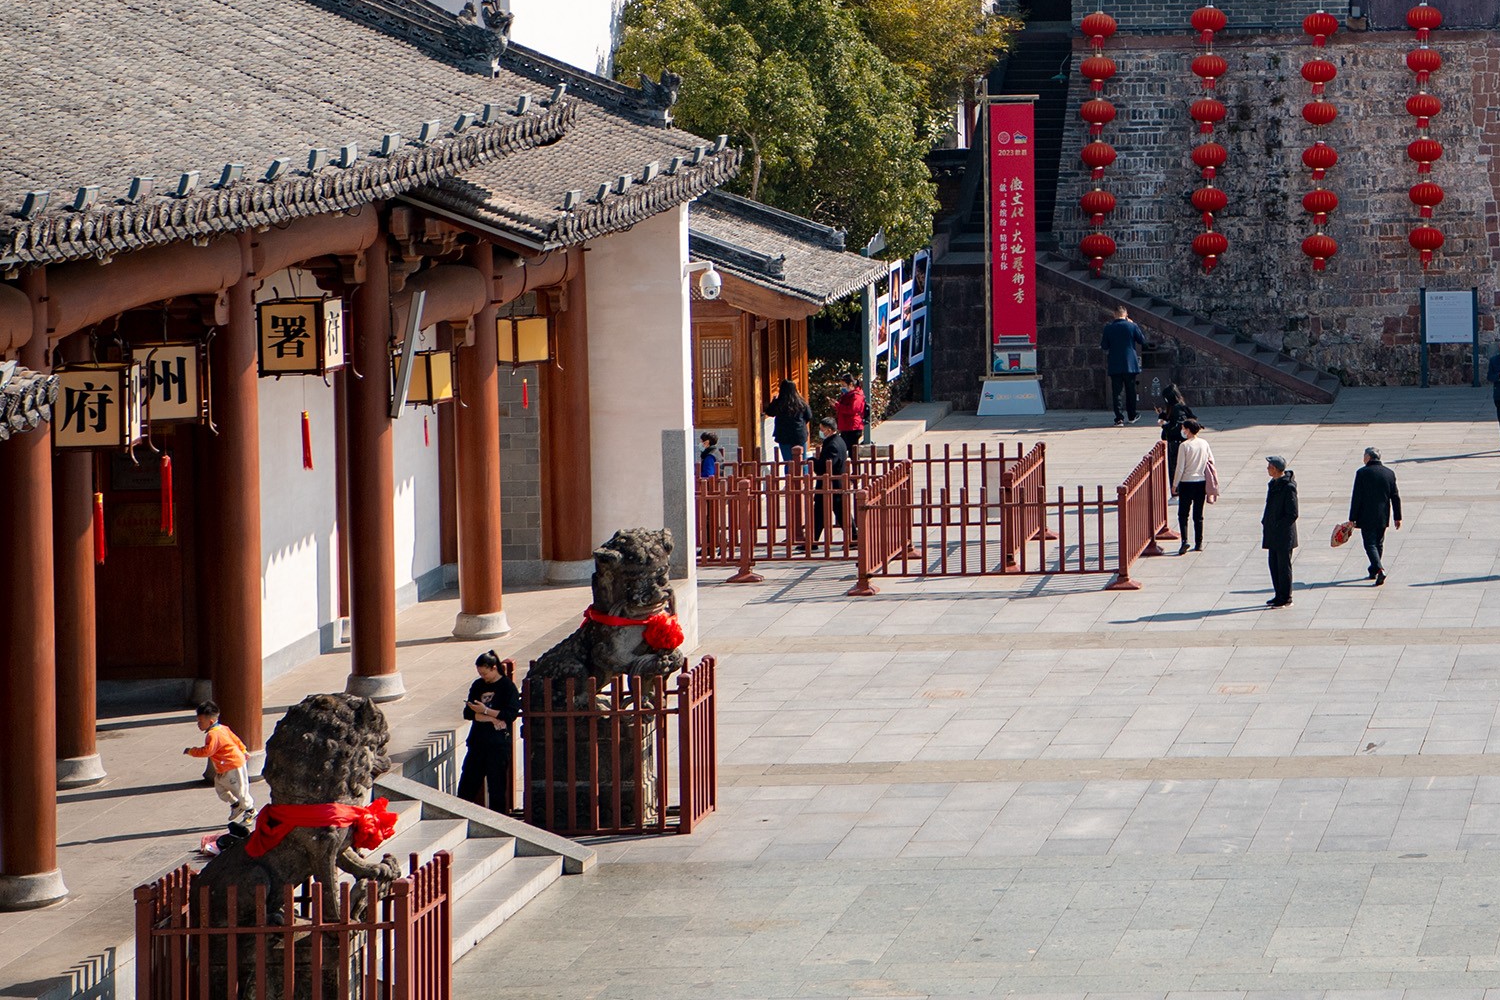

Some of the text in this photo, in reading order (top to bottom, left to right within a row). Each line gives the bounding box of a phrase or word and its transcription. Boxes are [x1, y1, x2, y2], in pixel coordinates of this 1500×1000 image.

[268, 315, 310, 359] 署
[141, 356, 187, 407] 州
[60, 382, 114, 433] 府
